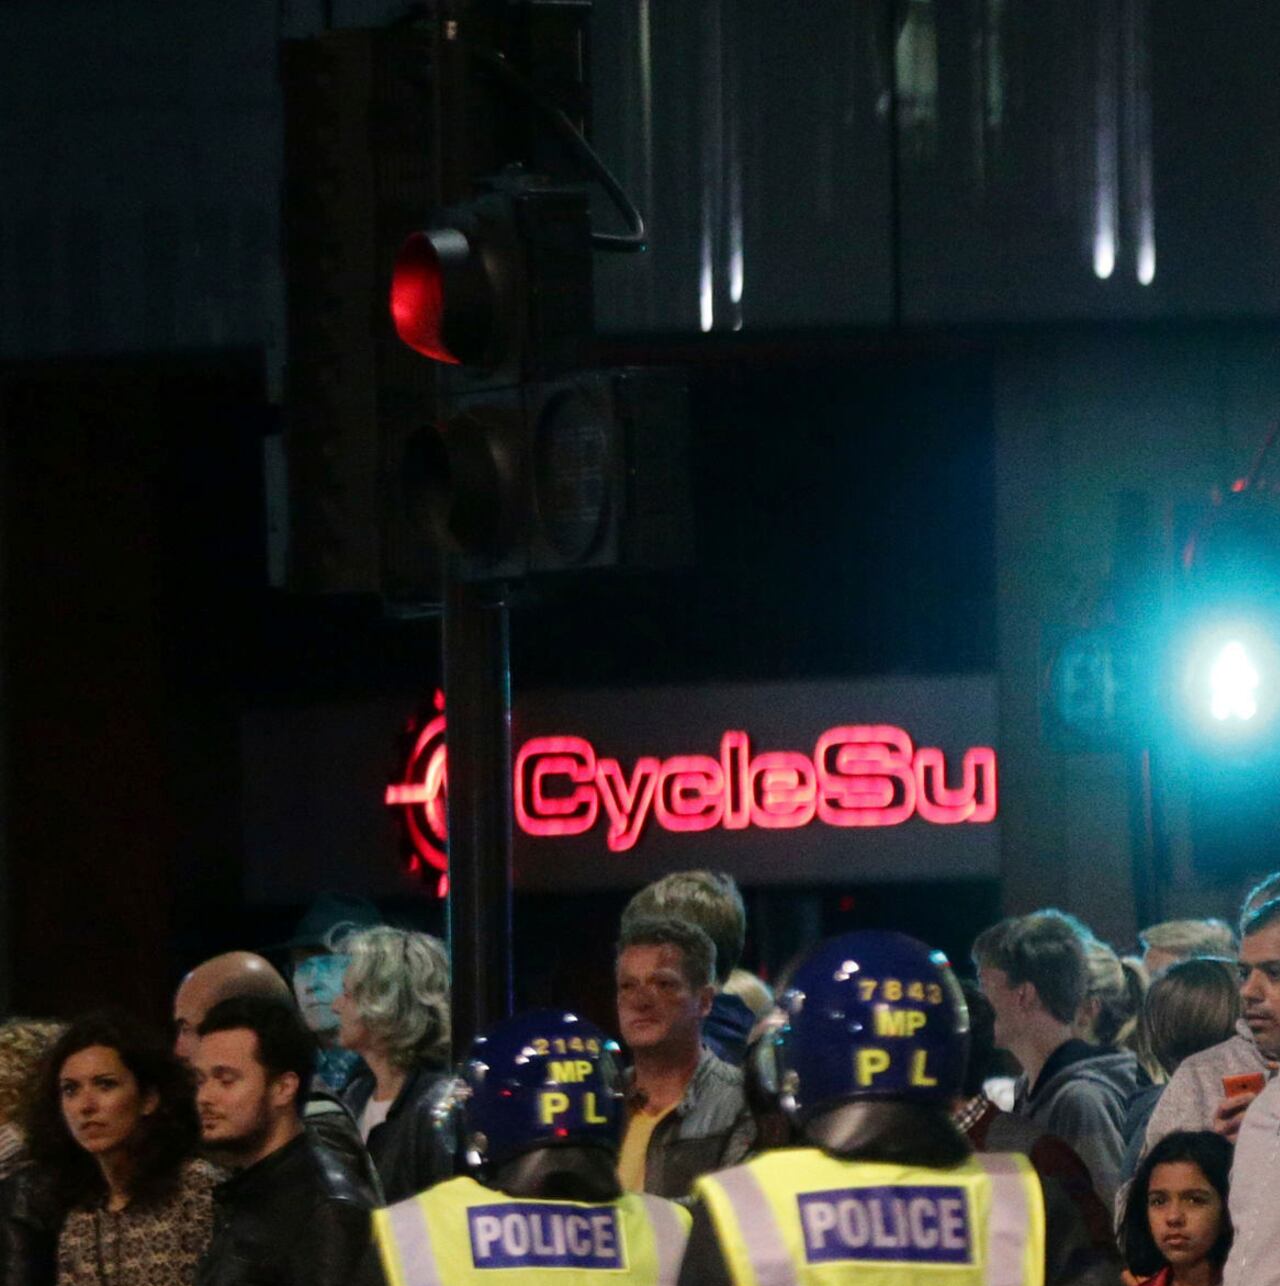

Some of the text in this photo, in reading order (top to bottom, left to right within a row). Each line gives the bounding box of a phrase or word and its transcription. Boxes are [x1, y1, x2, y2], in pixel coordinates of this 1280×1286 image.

[514, 723, 997, 852] CycleSu
[876, 1007, 927, 1037] MP
[548, 1060, 593, 1083] MP
[474, 1212, 616, 1258] POLICE
[804, 1197, 965, 1249] POLICE
